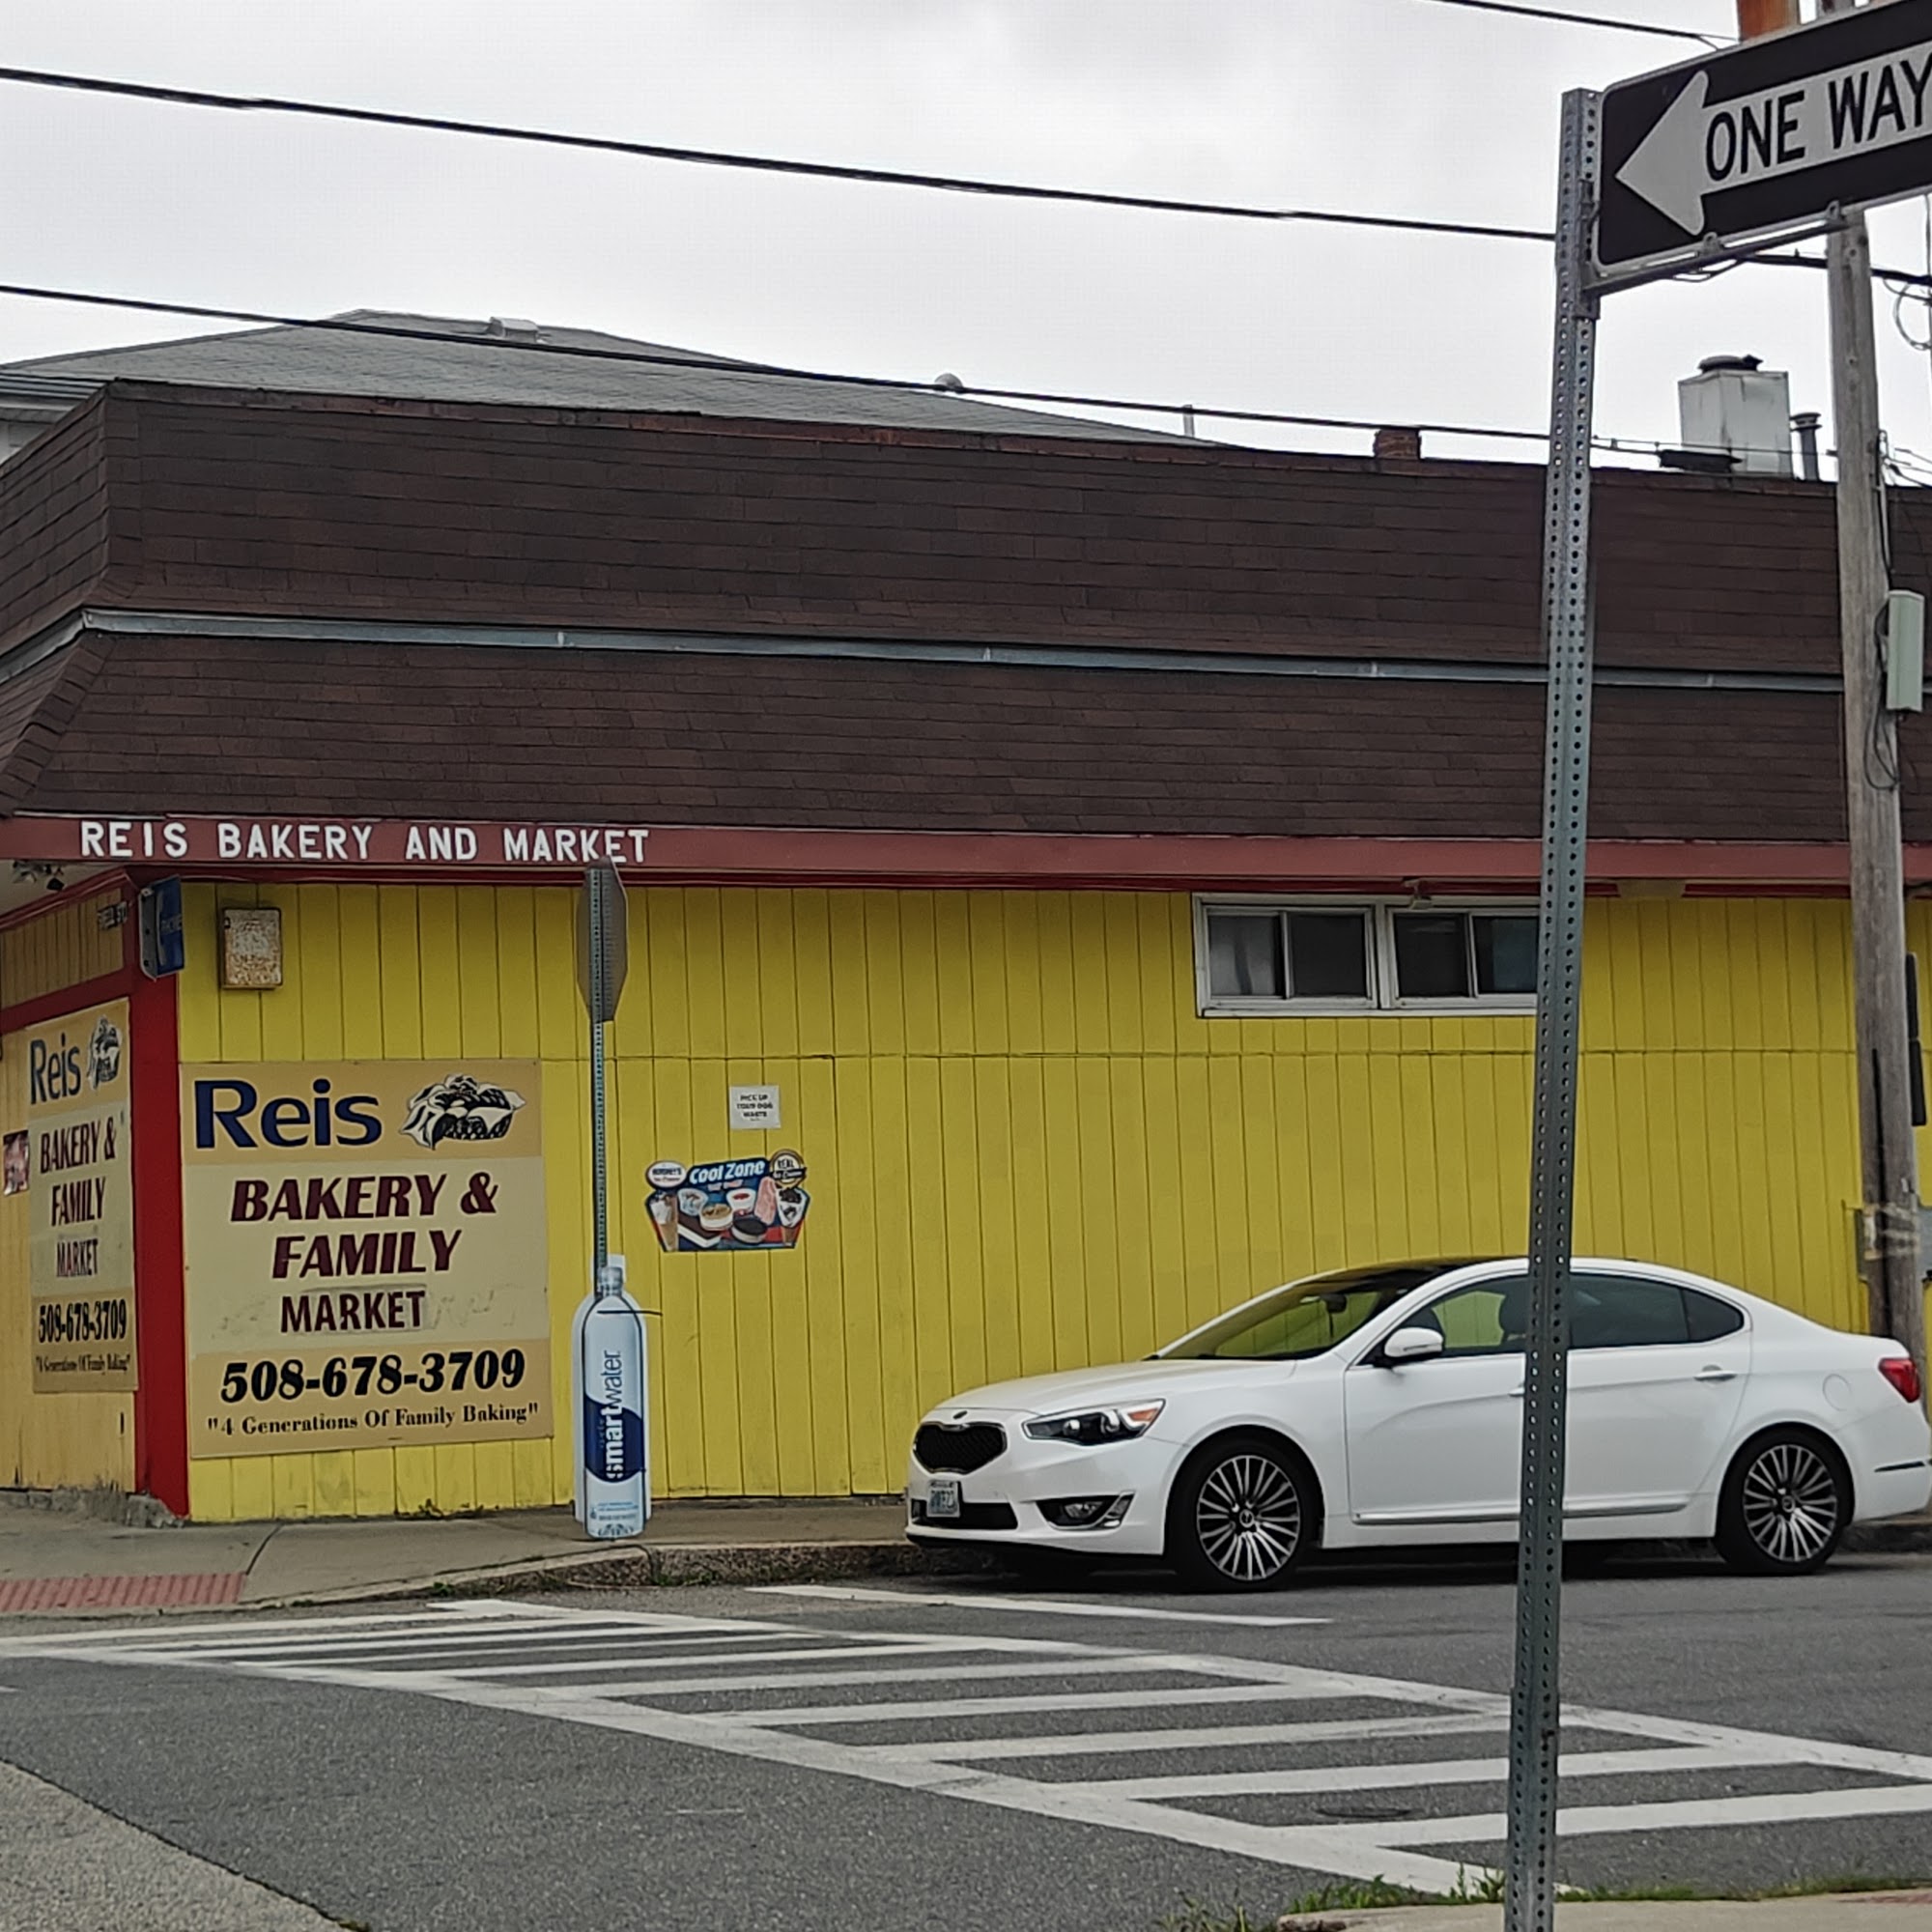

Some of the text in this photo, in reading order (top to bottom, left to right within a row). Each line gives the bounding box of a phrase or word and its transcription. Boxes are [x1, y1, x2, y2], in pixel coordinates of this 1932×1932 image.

[1705, 51, 1932, 182] ONE WAY
[81, 821, 649, 863] REIS BAKERY AND MARKET
[30, 1032, 82, 1105] Reis
[194, 1078, 383, 1149] Reis
[40, 1116, 117, 1175] BAKERY &
[230, 1171, 498, 1222] BAKERY &
[689, 1160, 766, 1184] Cool Zone
[51, 1176, 106, 1227] FAMILY
[56, 1238, 99, 1277] MARKET
[272, 1229, 462, 1278] FAMILY
[281, 1290, 426, 1333] MARKET
[220, 1349, 526, 1403] 508-678-3709
[242, 1413, 358, 1435] Generations
[364, 1408, 388, 1429] Of
[395, 1406, 454, 1429] Family
[600, 1350, 624, 1479] smartwater
